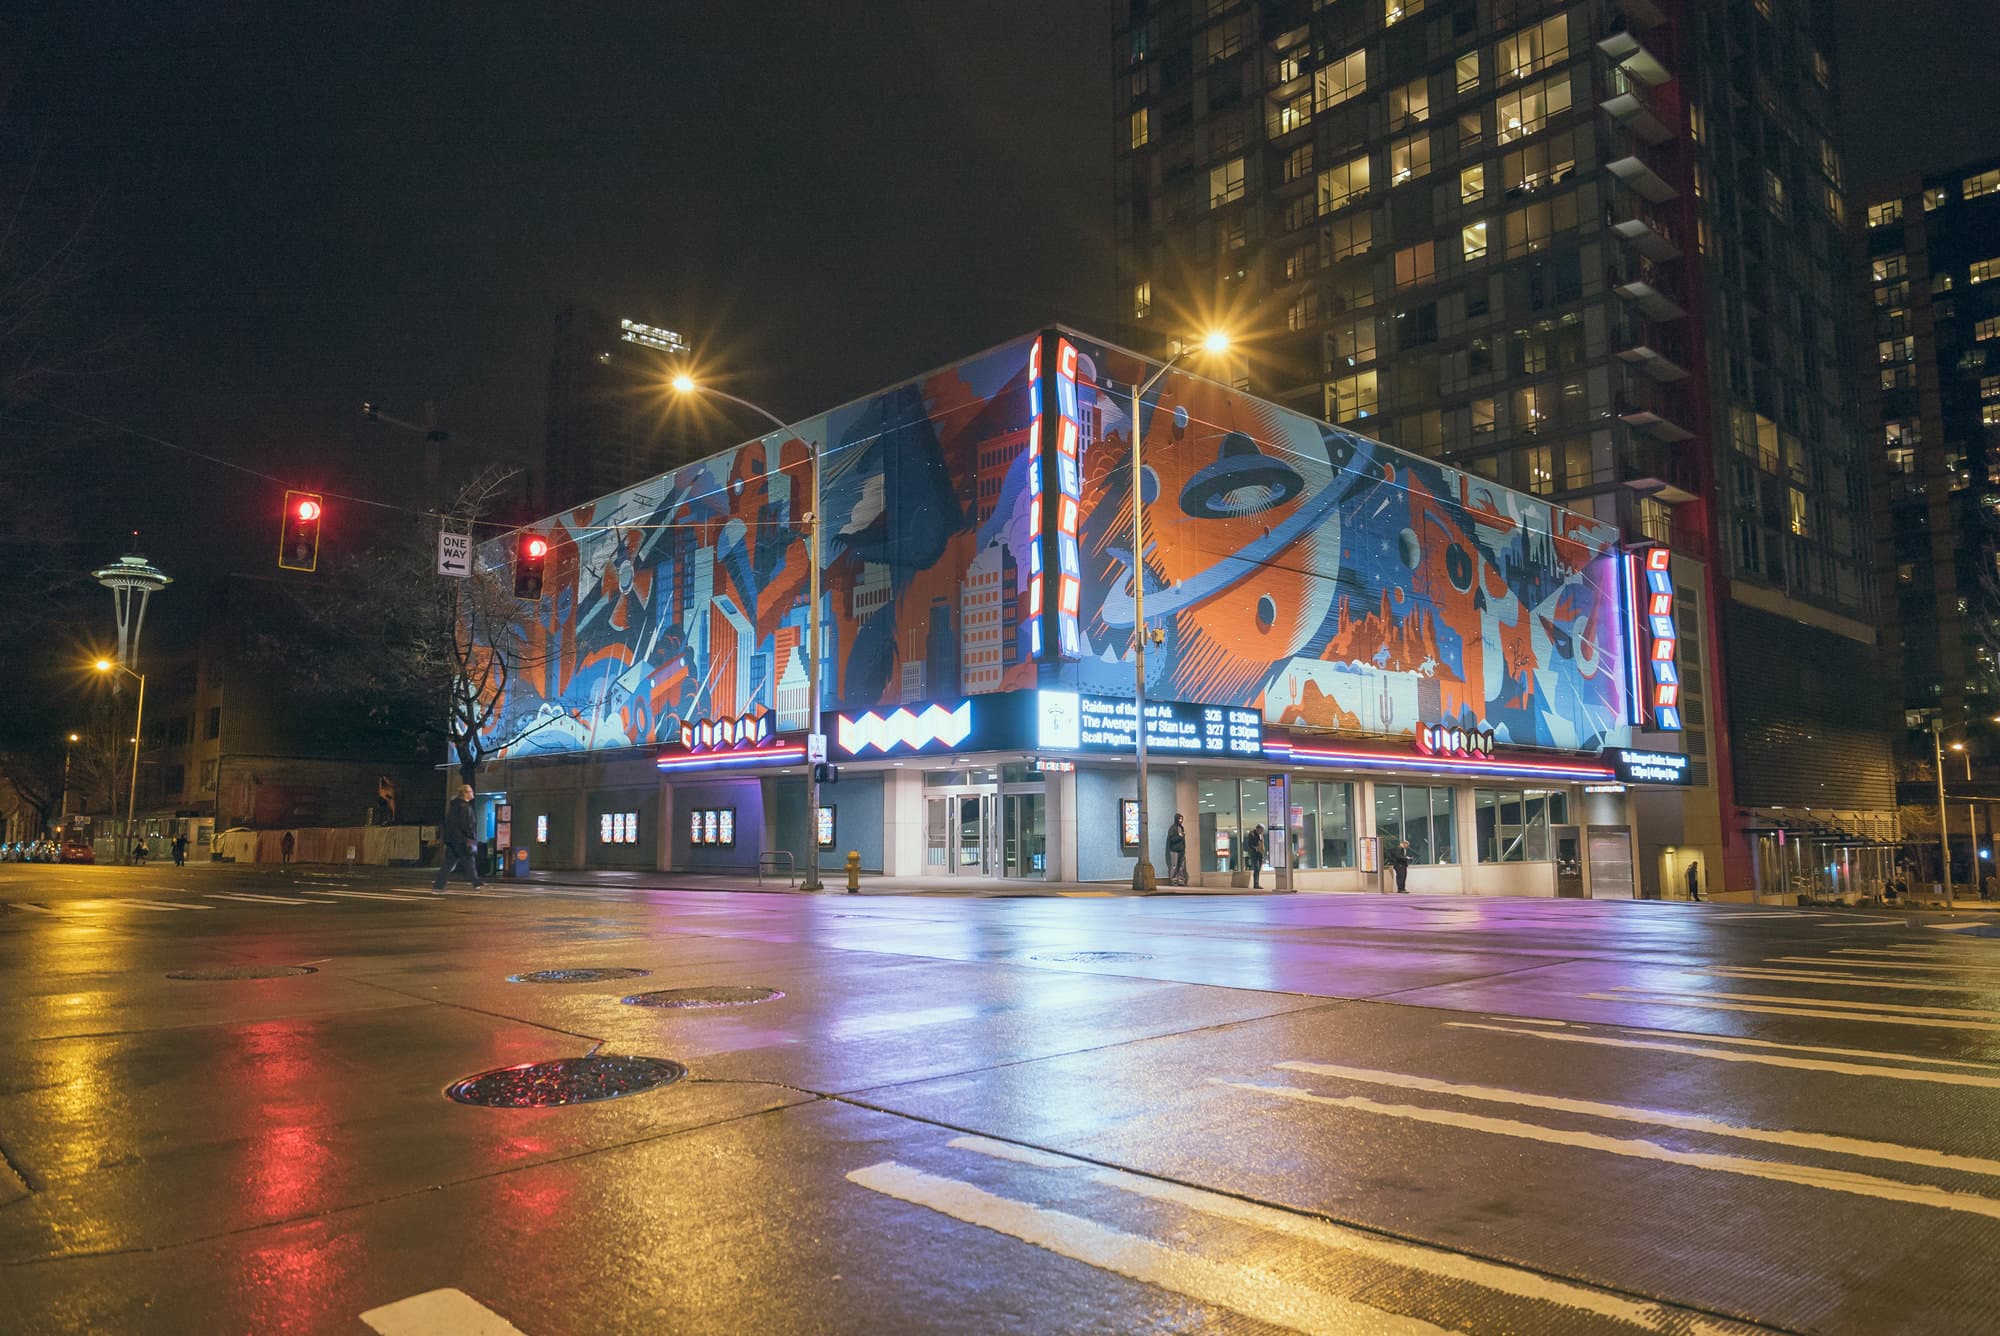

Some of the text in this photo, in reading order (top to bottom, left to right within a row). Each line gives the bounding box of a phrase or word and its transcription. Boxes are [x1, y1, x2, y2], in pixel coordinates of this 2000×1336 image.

[1060, 344, 1080, 656] CINERAMA
[443, 536, 467, 549] ONE
[443, 547, 467, 559] WAY
[1650, 550, 1678, 728] CINERAMA
[1082, 699, 1114, 714] Raiders
[1116, 702, 1124, 715] of
[1144, 705, 1157, 717] ost
[681, 716, 767, 749] CINERAMA
[1082, 715, 1101, 728] The
[1102, 716, 1137, 733] Avenge
[1159, 720, 1178, 733] Stan
[1179, 721, 1196, 734] Lee
[1206, 724, 1224, 736] 3/27
[1082, 731, 1102, 744] Scott
[1147, 735, 1178, 747] Brandon
[1423, 728, 1493, 754] CINERAMA
